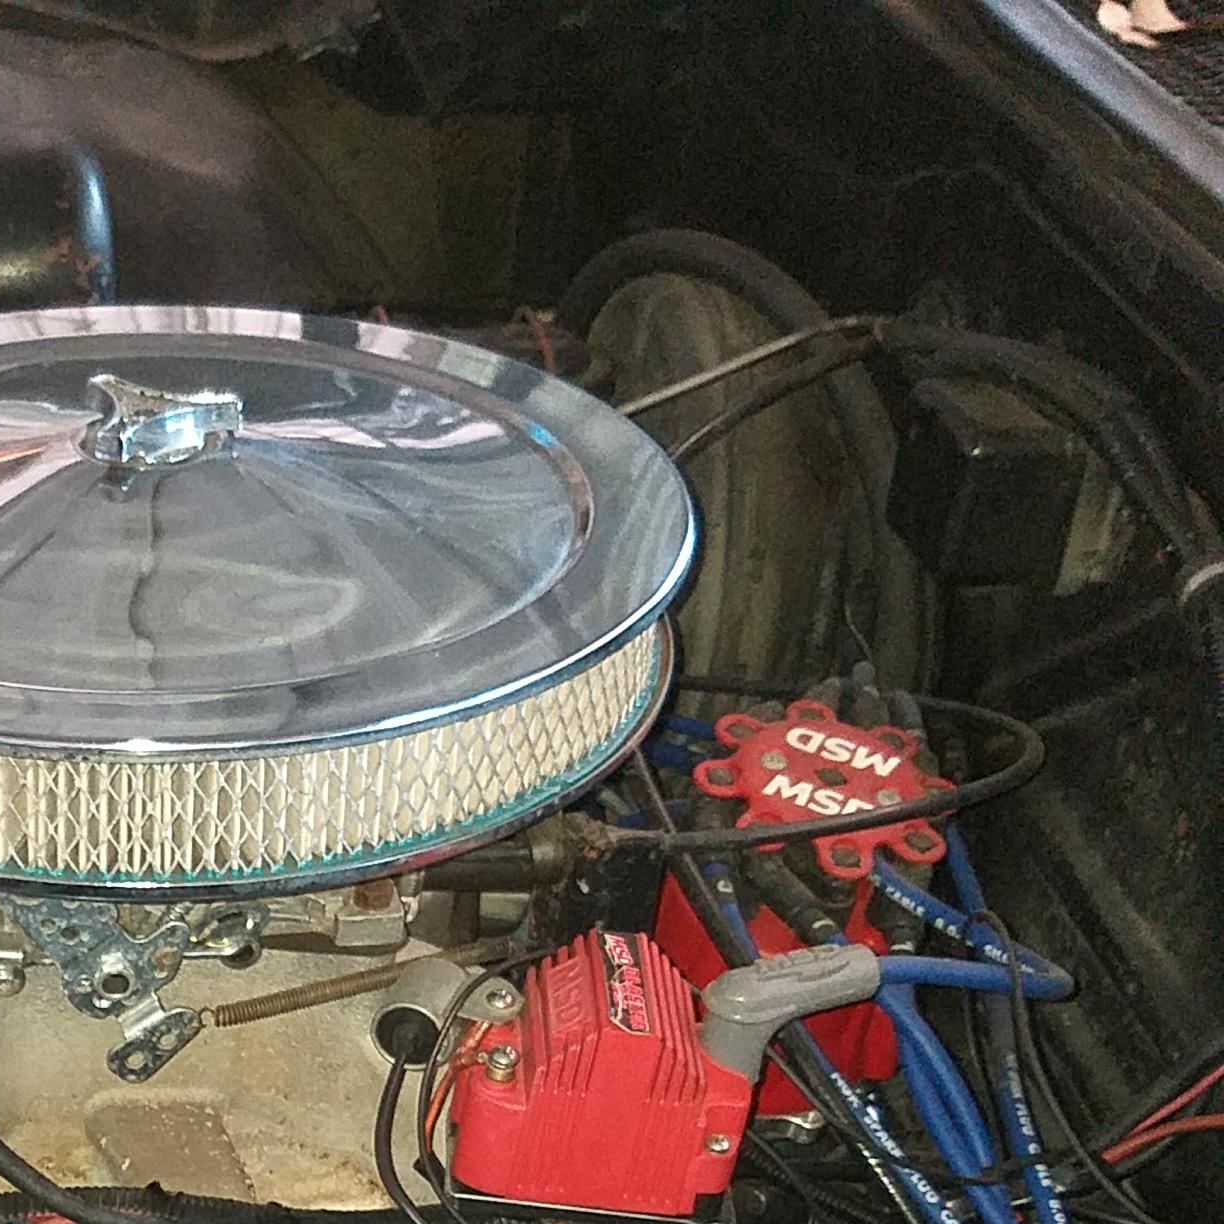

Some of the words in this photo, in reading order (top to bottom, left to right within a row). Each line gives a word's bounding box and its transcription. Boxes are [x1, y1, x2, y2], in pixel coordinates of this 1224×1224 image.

[786, 727, 901, 777] MSD
[830, 1072, 861, 1108] NGK
[903, 1167, 939, 1203] LUG
